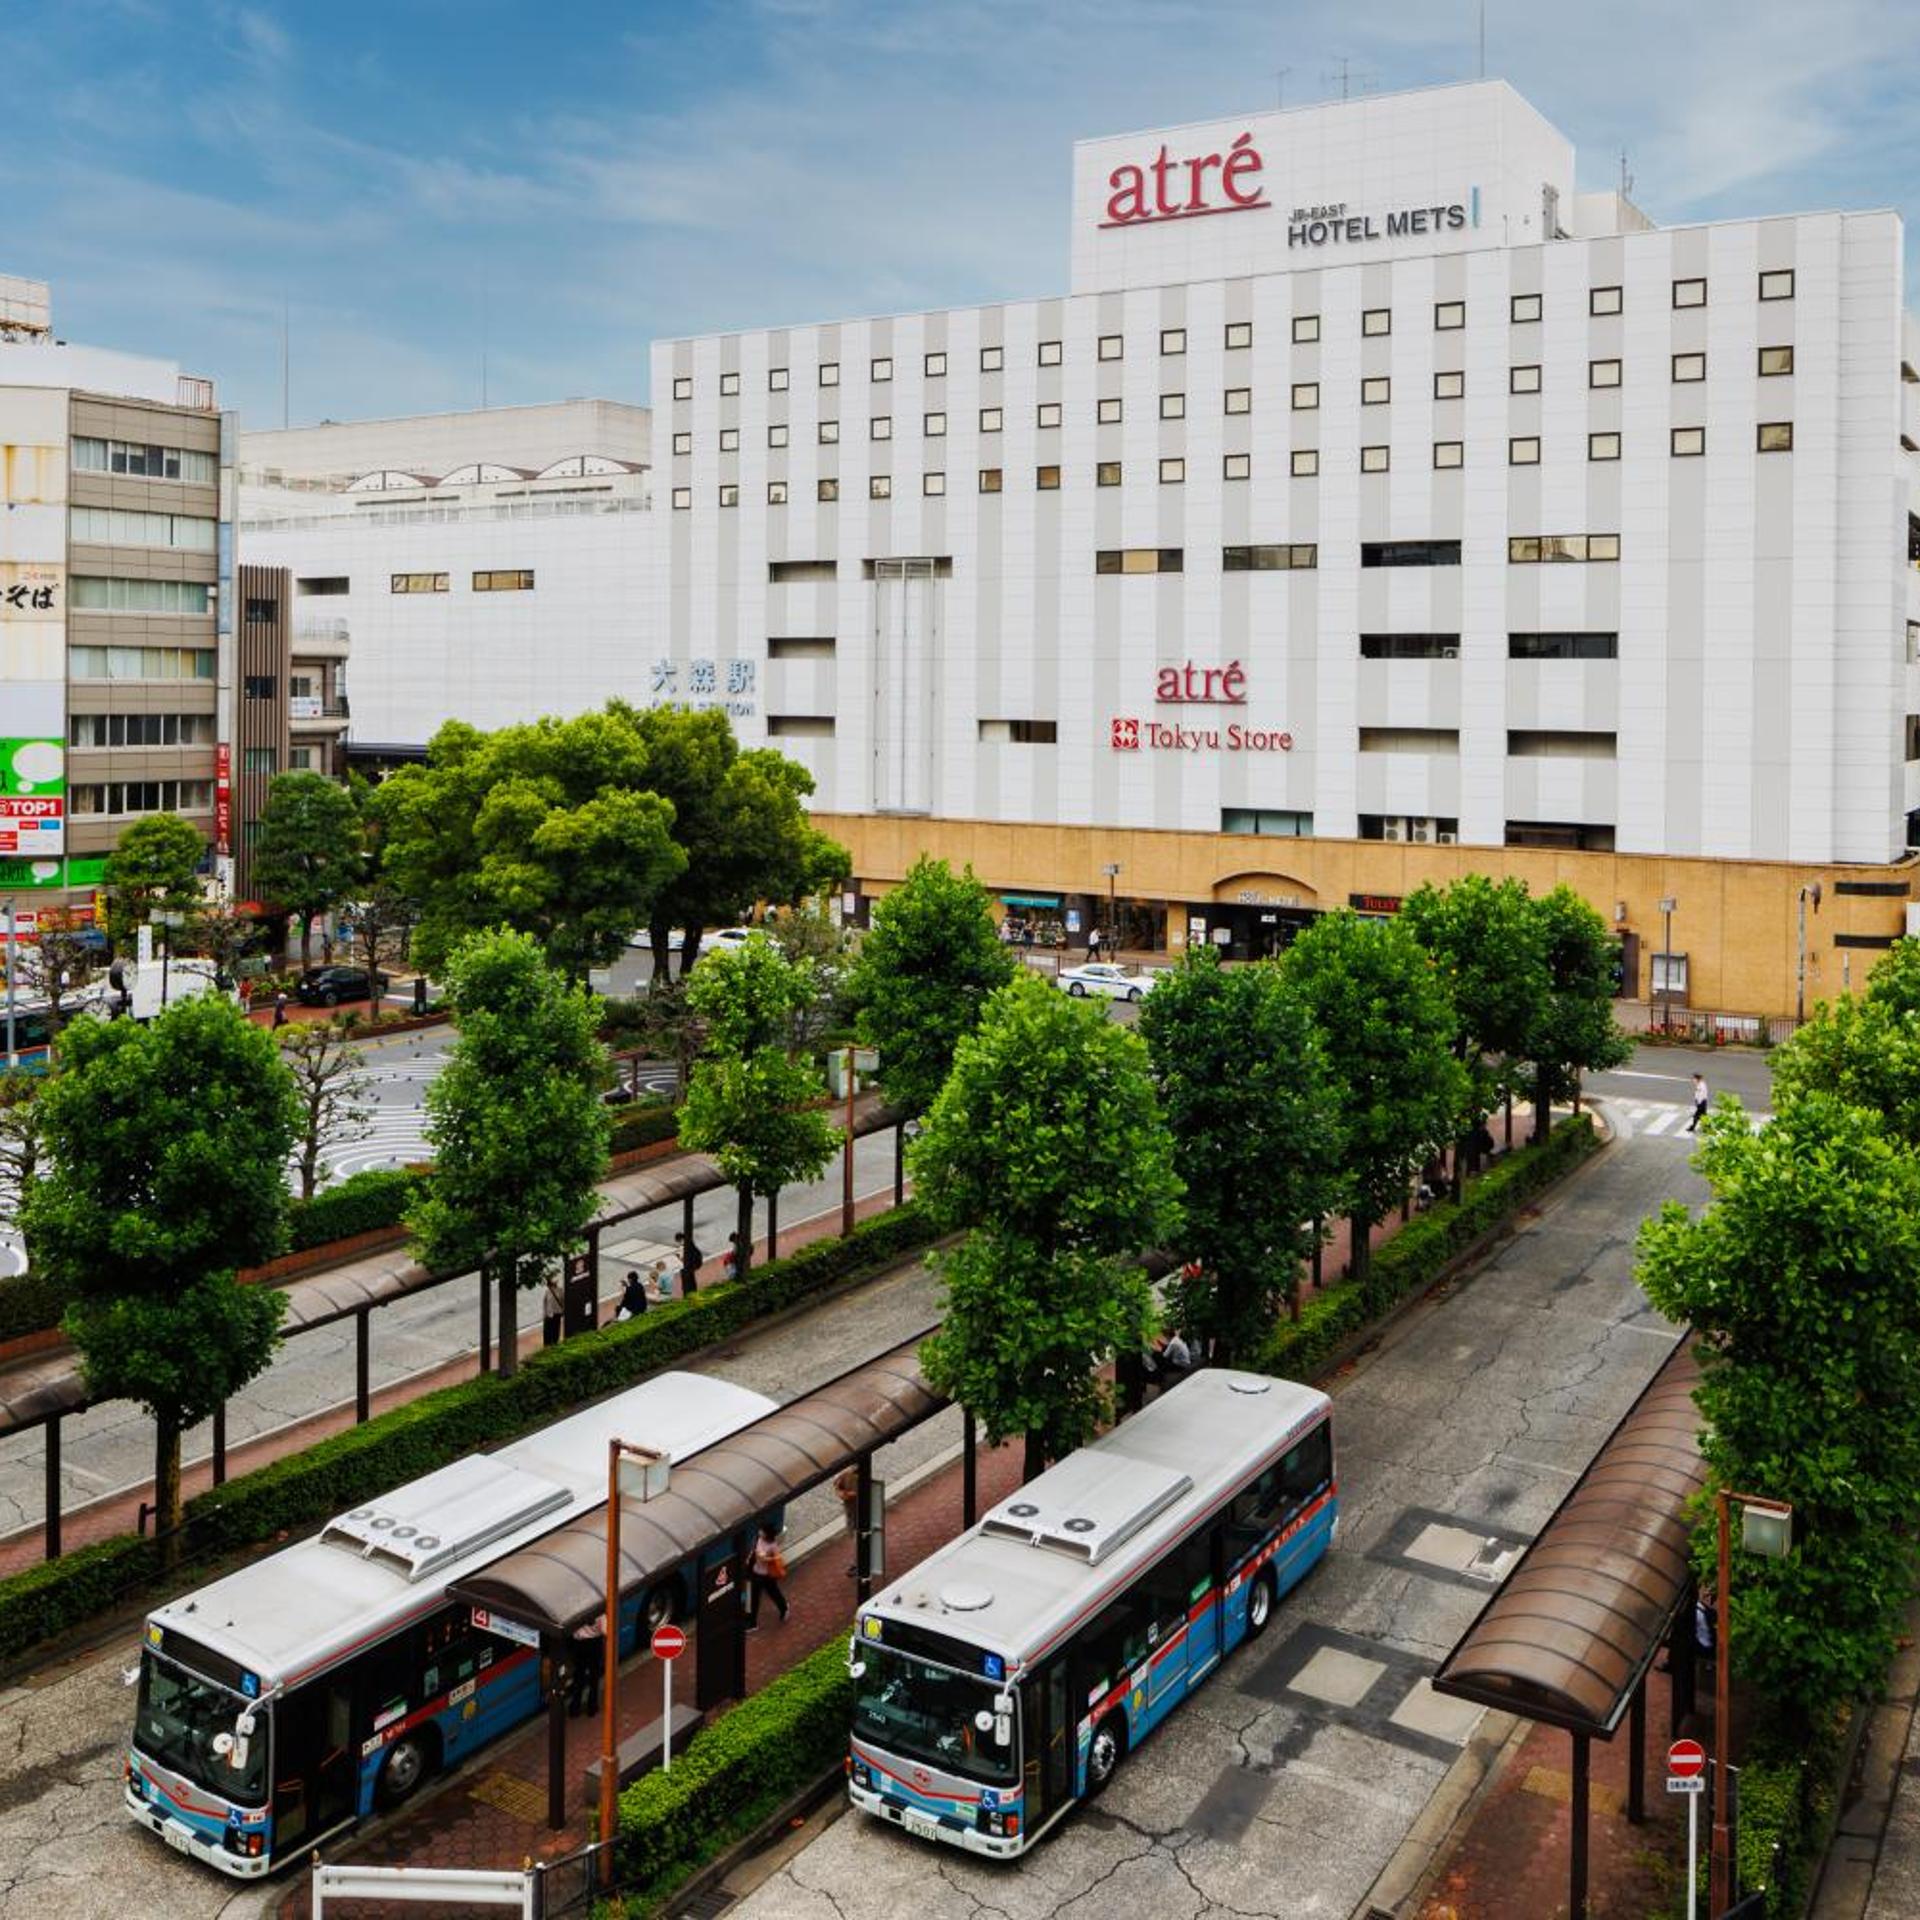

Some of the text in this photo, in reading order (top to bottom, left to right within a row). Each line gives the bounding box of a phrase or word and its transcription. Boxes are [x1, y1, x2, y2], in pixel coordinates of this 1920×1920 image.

[1107, 132, 1264, 221] atré
[1287, 204, 1466, 247] HOTEL METS
[651, 660, 756, 693] 大森駅
[1157, 660, 1247, 700] atré
[1145, 723, 1292, 751] Tokyu Store
[10, 800, 56, 815] TOP1
[475, 1610, 487, 1625] 4
